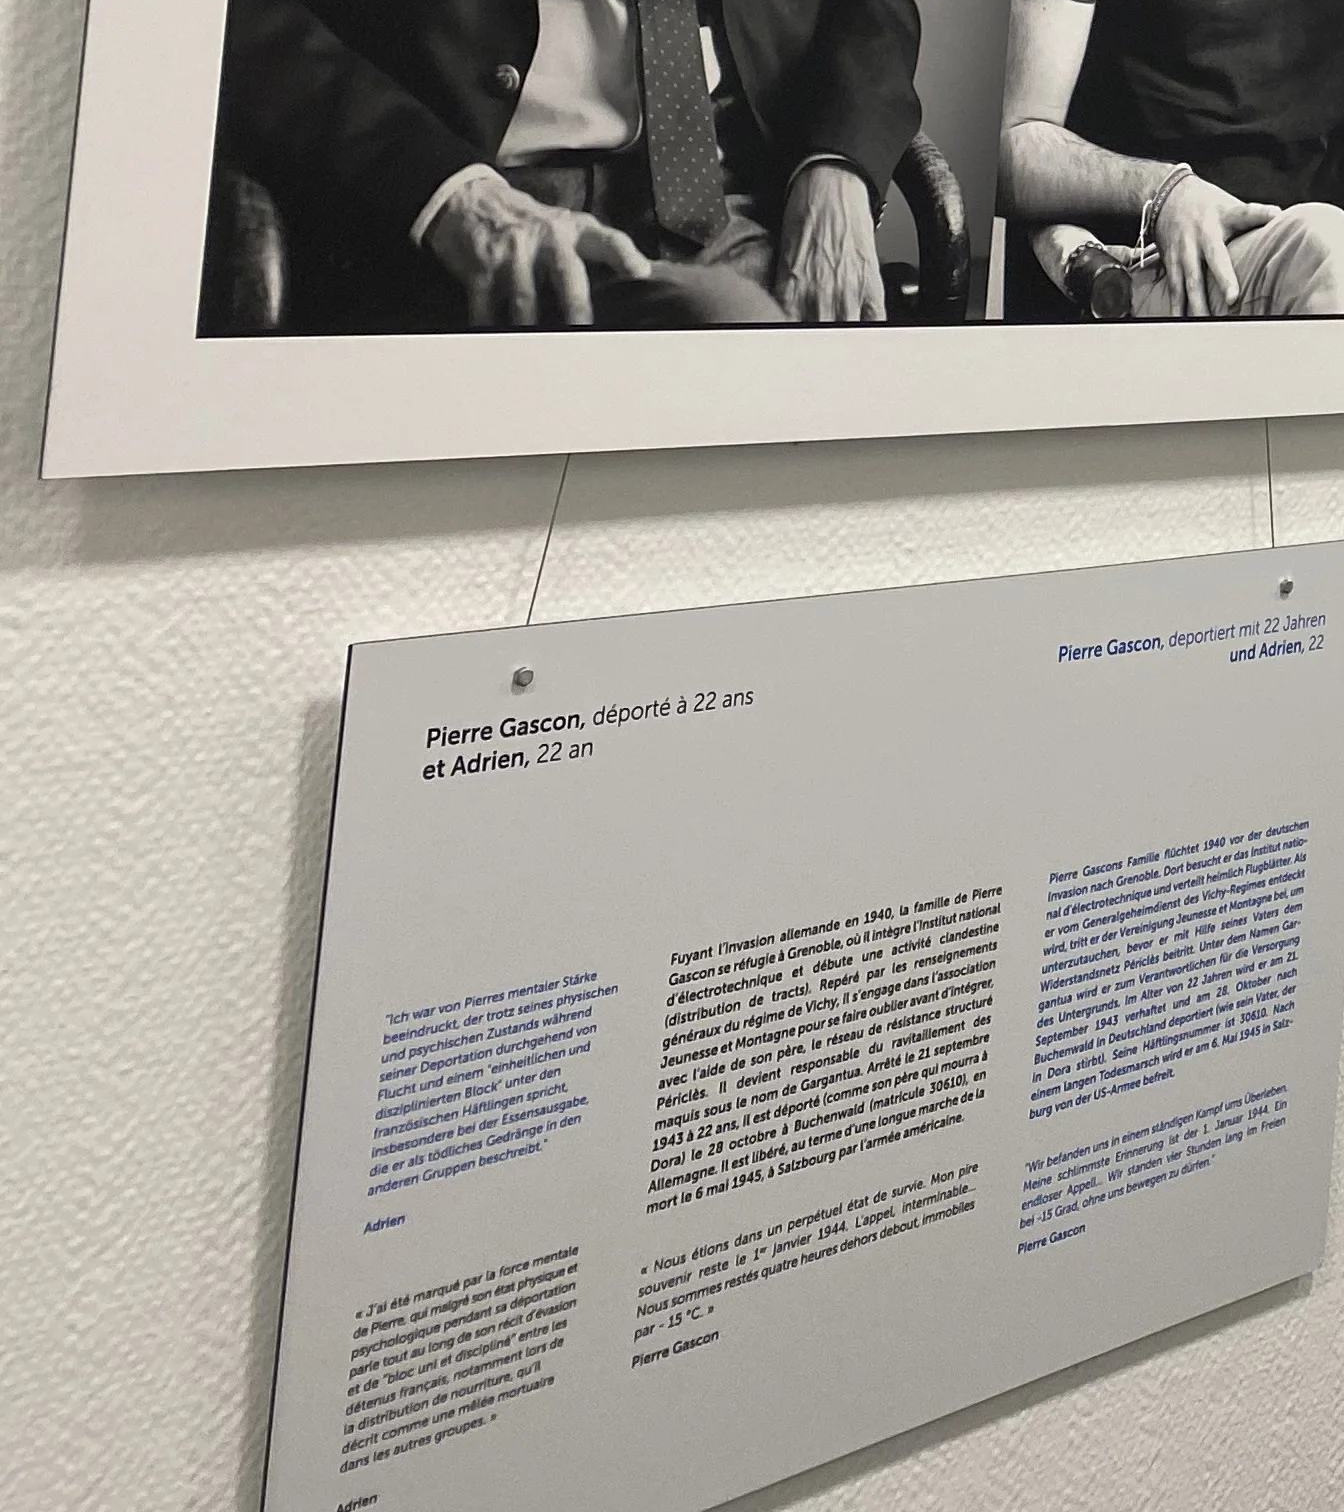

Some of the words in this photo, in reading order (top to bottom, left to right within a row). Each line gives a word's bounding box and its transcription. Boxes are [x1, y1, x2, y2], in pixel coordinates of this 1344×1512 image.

[1058, 644, 1103, 664] Pierre
[1106, 637, 1165, 656] Gascon,
[1168, 624, 1236, 648] deportiert
[1239, 621, 1261, 638] mit
[1263, 617, 1281, 635] 22
[1282, 614, 1327, 633] Jahren
[1229, 643, 1257, 664] und
[1258, 639, 1305, 660] Adrien,
[1308, 634, 1325, 652] 22
[426, 725, 494, 750] Pierre
[499, 714, 586, 739] Gascon,
[592, 697, 672, 727] déporté
[676, 696, 688, 715] à
[693, 691, 717, 713] 22
[722, 691, 754, 709] ans
[422, 759, 447, 781] et
[450, 750, 531, 777] Adrien,
[537, 741, 563, 765] 22
[569, 742, 594, 760] an
[1047, 885, 1089, 903] Invasion
[1090, 878, 1115, 894] nach
[1115, 868, 1162, 888] Grenoble.
[1163, 863, 1185, 878] Dort
[1185, 855, 1223, 873] besucht
[1222, 854, 1234, 864] er
[1233, 850, 1250, 862] das
[1250, 841, 1282, 858] Institut
[1282, 837, 1309, 851] natio-
[1049, 870, 1079, 885] Pierre
[1082, 860, 1124, 878] Gascons
[1126, 851, 1161, 868] Familie
[1163, 843, 1200, 860] flüchtet
[1203, 836, 1227, 852] 1940
[1229, 835, 1245, 846] vor
[1247, 830, 1263, 842] der
[1265, 821, 1310, 838] deutschen
[1046, 906, 1063, 921] nal
[1153, 881, 1173, 897] und
[1172, 875, 1206, 892] verteilt
[1206, 866, 1245, 885] heimlich
[1244, 856, 1293, 876] Flugblätter.
[1293, 852, 1308, 865] Als
[668, 967, 717, 987] Gascon
[717, 964, 732, 977] se
[733, 952, 777, 973] réfugie
[777, 949, 786, 963] à
[787, 938, 845, 961] Grenoble,
[846, 932, 862, 948] où
[863, 930, 871, 944] il
[872, 924, 912, 942] intègre
[958, 902, 1002, 923] national
[670, 946, 714, 966] Fuyant
[779, 919, 841, 943] allemande
[844, 916, 860, 929] en
[863, 907, 895, 926] 1940,
[899, 905, 910, 917] la
[913, 896, 951, 914] famille
[954, 892, 969, 906] de
[971, 886, 1003, 902] Pierre
[791, 965, 804, 979] et
[812, 955, 854, 975] débute
[861, 949, 884, 963] une
[891, 936, 932, 957] activité
[939, 923, 1000, 945] clandestine
[412, 1007, 437, 1021] war
[438, 1001, 462, 1015] von
[464, 992, 506, 1010] Pierres
[507, 980, 561, 1001] mentaler
[562, 972, 598, 989] Stärke
[662, 1025, 723, 1052] généraux
[723, 1019, 741, 1034] du
[742, 1010, 786, 1030] régime
[787, 1004, 804, 1019] de
[805, 997, 841, 1014] Vichy,
[842, 991, 851, 1006] il
[903, 975, 930, 991] dans
[664, 1001, 742, 1030] (distribution
[748, 994, 765, 1009] de
[771, 982, 813, 1003] tracts).
[819, 970, 860, 992] Repéré
[866, 967, 887, 984] par
[891, 962, 908, 975] les
[913, 941, 998, 970] renseignements
[381, 1047, 407, 1065] und
[408, 1032, 485, 1061] psychischen
[486, 1018, 541, 1041] Zustands
[542, 1005, 593, 1028] während
[383, 1019, 461, 1046] beeindruckt,
[462, 1014, 485, 1028] der
[486, 1007, 516, 1023] trotz
[517, 999, 554, 1016] seines
[556, 985, 619, 1010] physischen
[363, 1215, 407, 1236] Adrien
[1017, 1237, 1048, 1256] Pierre
[1049, 1224, 1087, 1244] Gascon
[390, 1294, 412, 1311] été
[413, 1279, 462, 1304] marqué
[463, 1274, 484, 1292] par
[485, 1270, 497, 1282] la
[499, 1260, 531, 1279] force
[532, 1245, 580, 1268] mentale
[631, 1347, 671, 1370] Pierre
[672, 1330, 720, 1355] Gascon
[337, 1494, 377, 1512] Adrien
